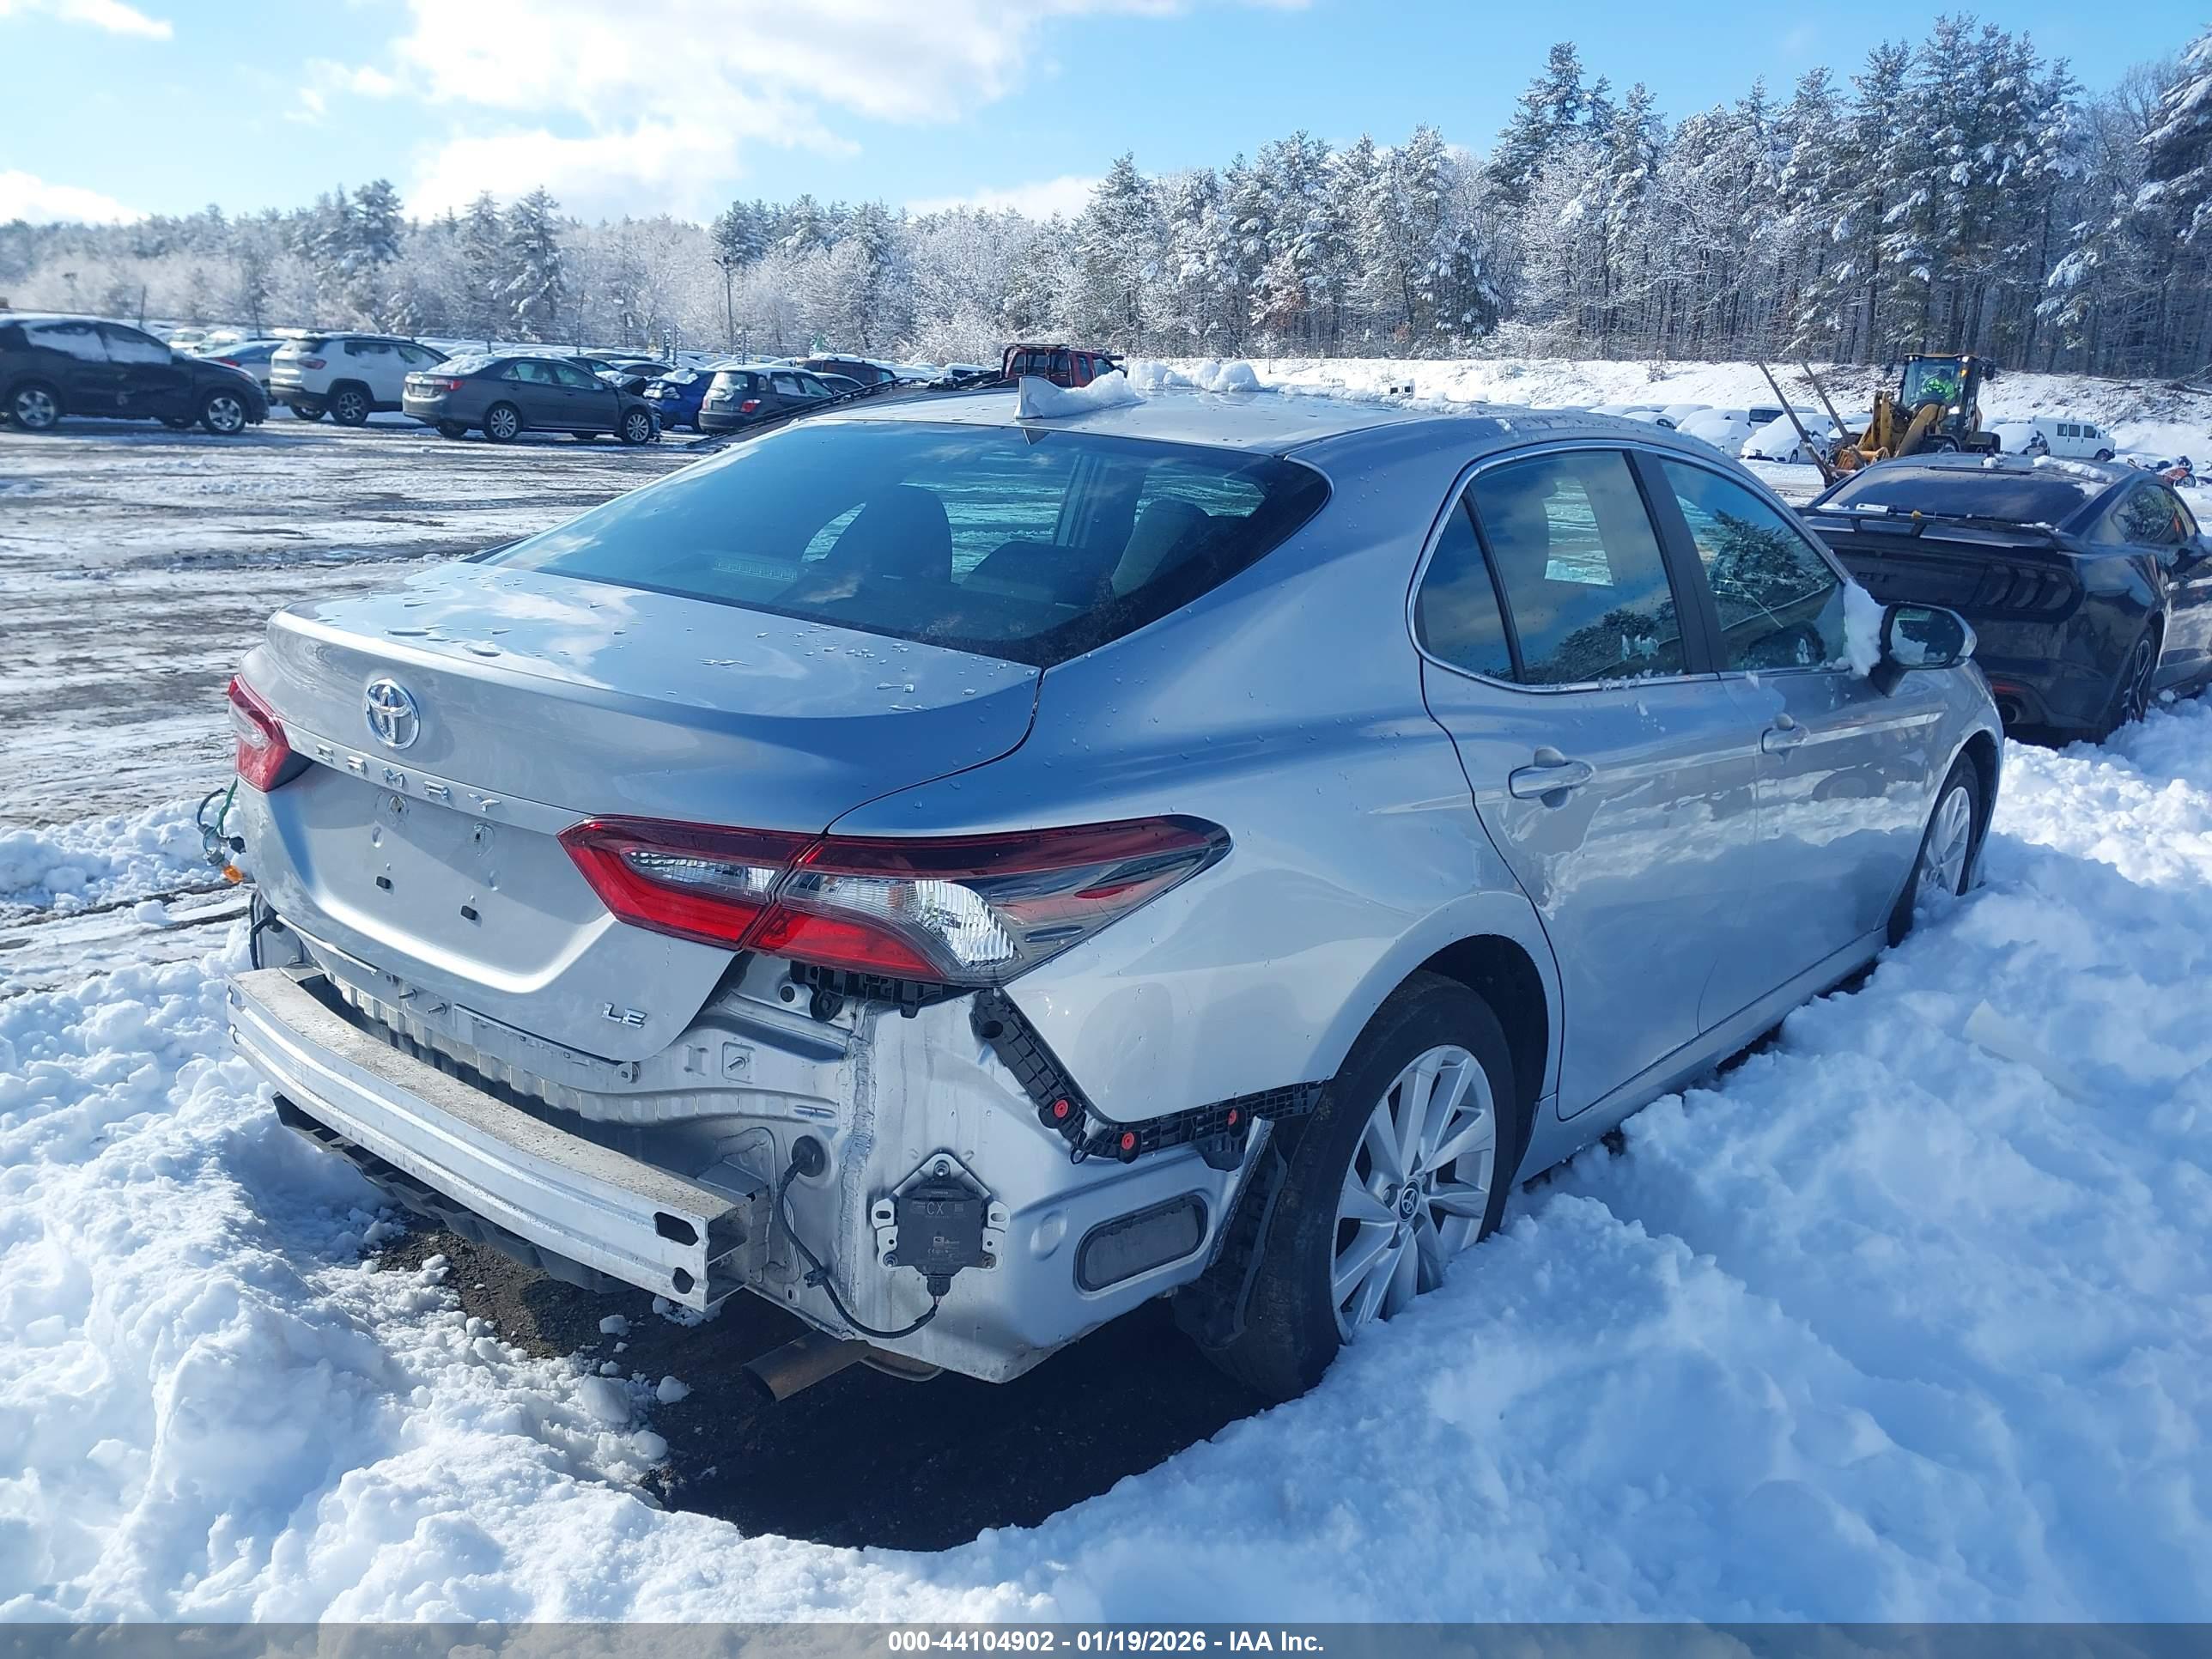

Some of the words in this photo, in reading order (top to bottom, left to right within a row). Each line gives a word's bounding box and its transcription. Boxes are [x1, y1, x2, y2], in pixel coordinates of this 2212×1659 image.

[315, 743, 502, 813] CAMRY
[601, 1001, 647, 1029] LE
[927, 1201, 945, 1215] CX
